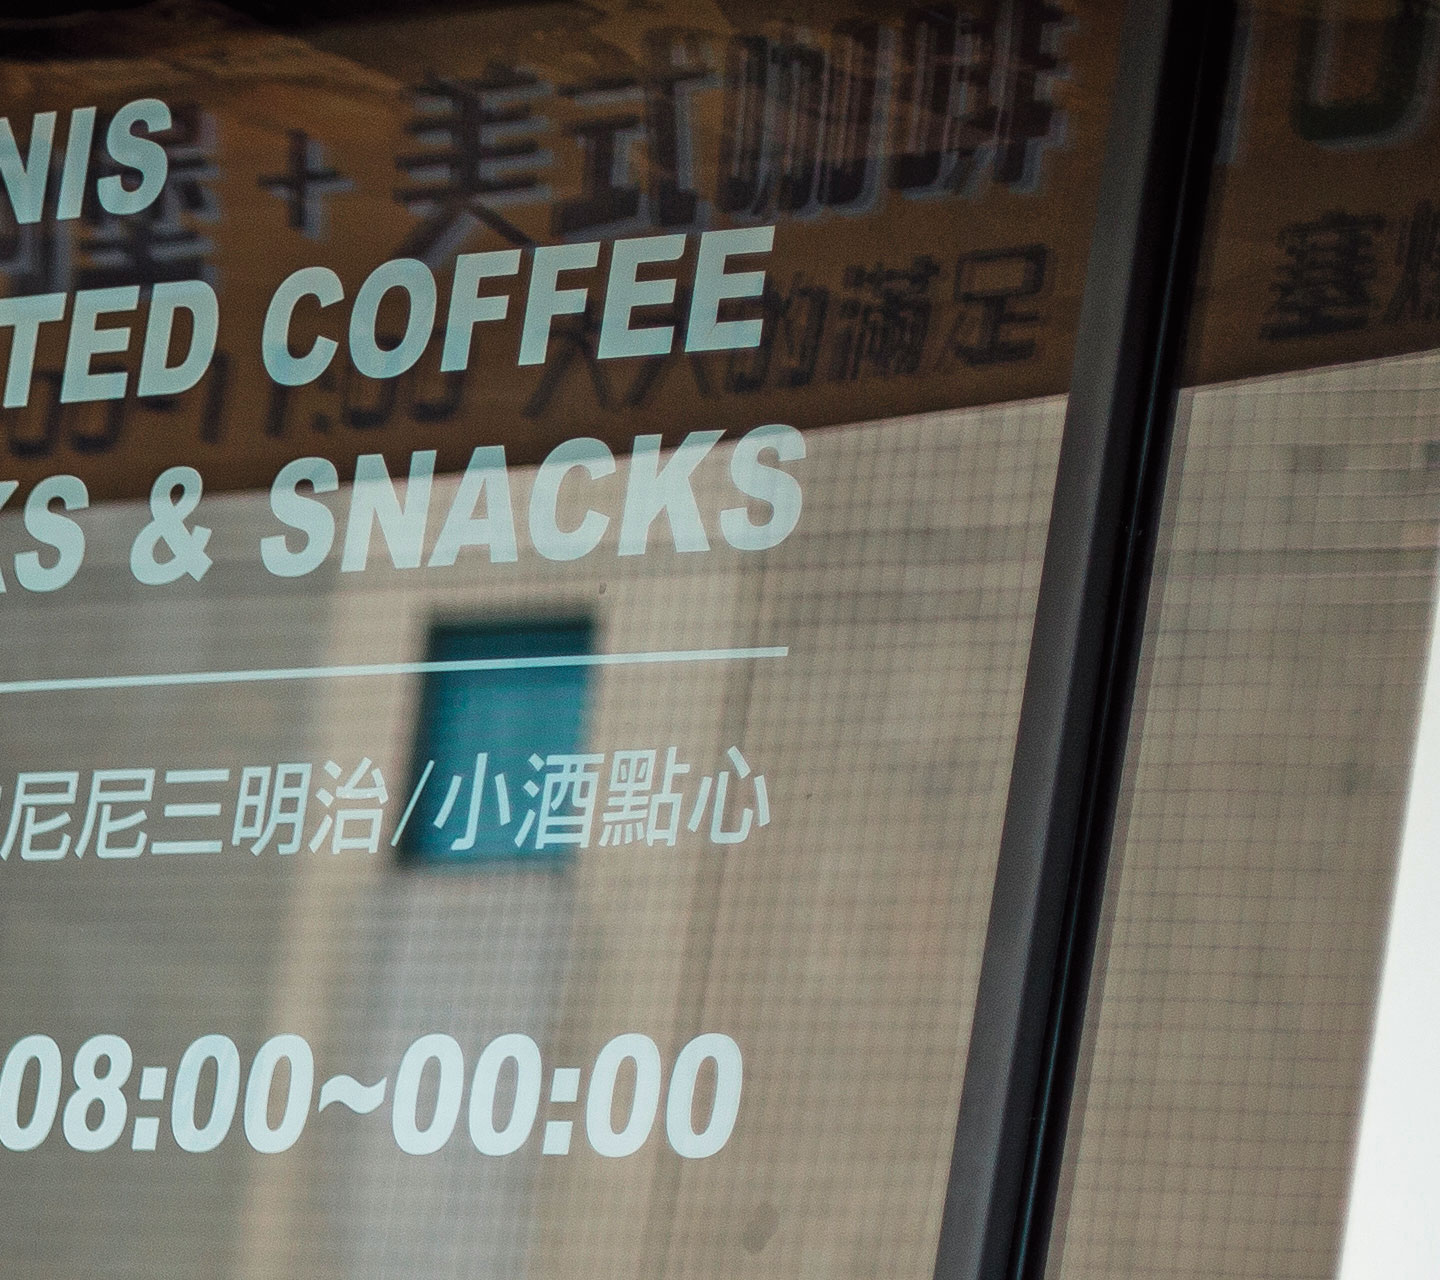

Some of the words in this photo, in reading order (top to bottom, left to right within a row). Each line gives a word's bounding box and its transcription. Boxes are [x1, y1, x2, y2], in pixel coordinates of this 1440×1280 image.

[261, 224, 777, 387] COFFEE
[127, 464, 214, 587] &
[259, 422, 807, 579] SNACKS
